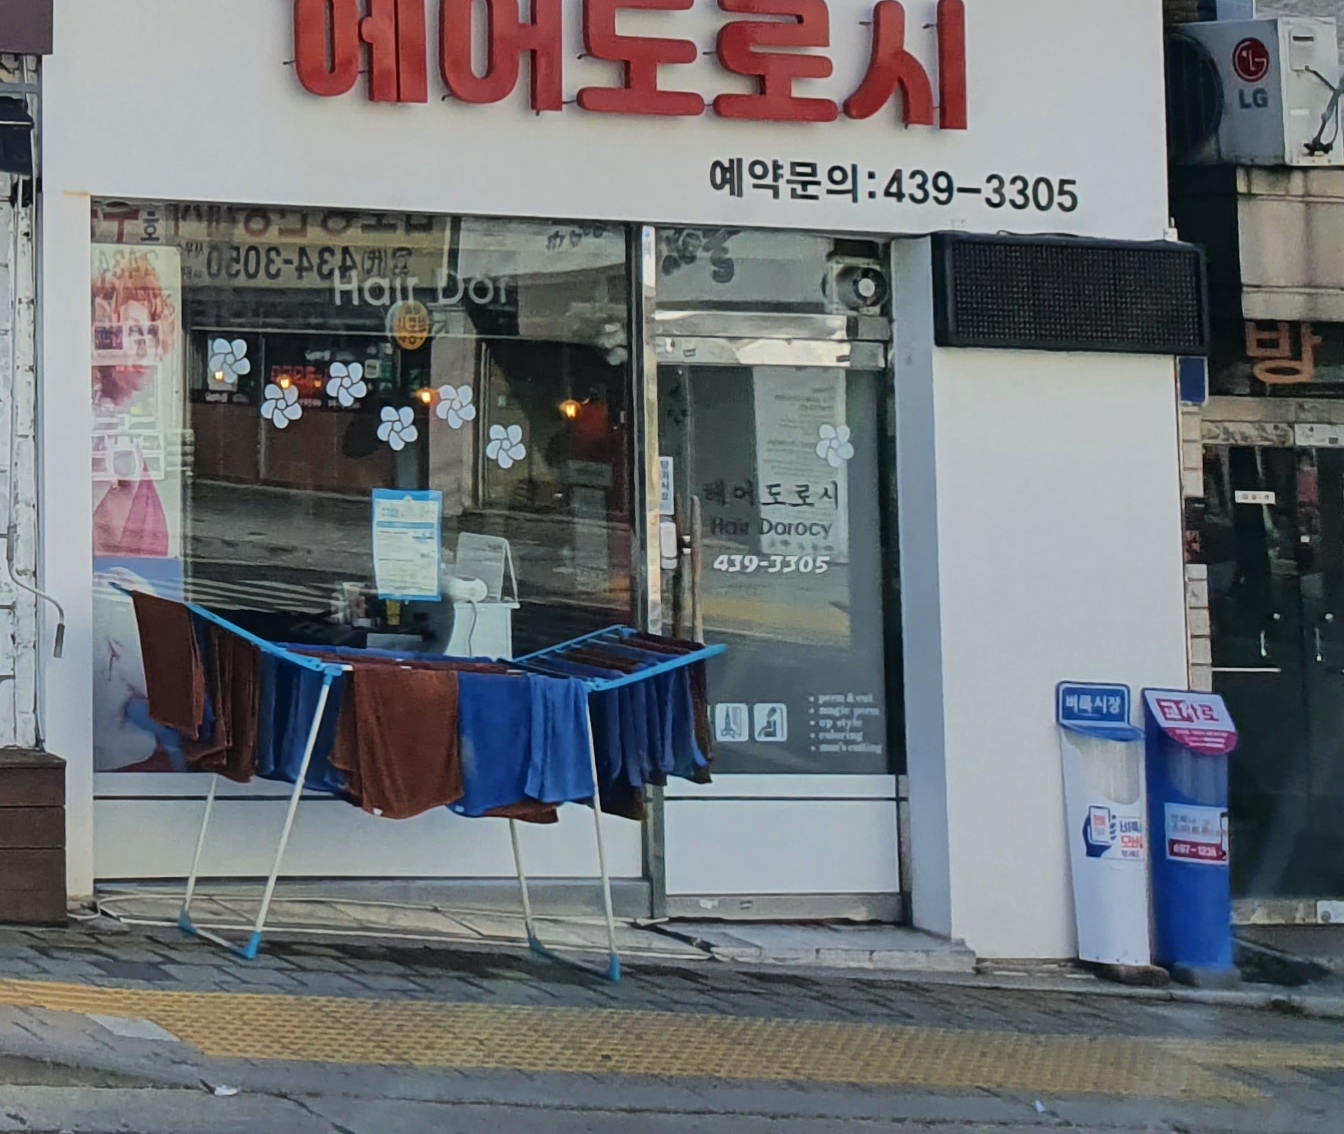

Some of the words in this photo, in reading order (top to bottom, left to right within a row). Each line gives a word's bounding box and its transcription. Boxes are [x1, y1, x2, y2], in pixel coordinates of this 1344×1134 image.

[1238, 88, 1268, 109] LG
[760, 518, 833, 540] Dorocy
[713, 554, 830, 574] 439-3305
